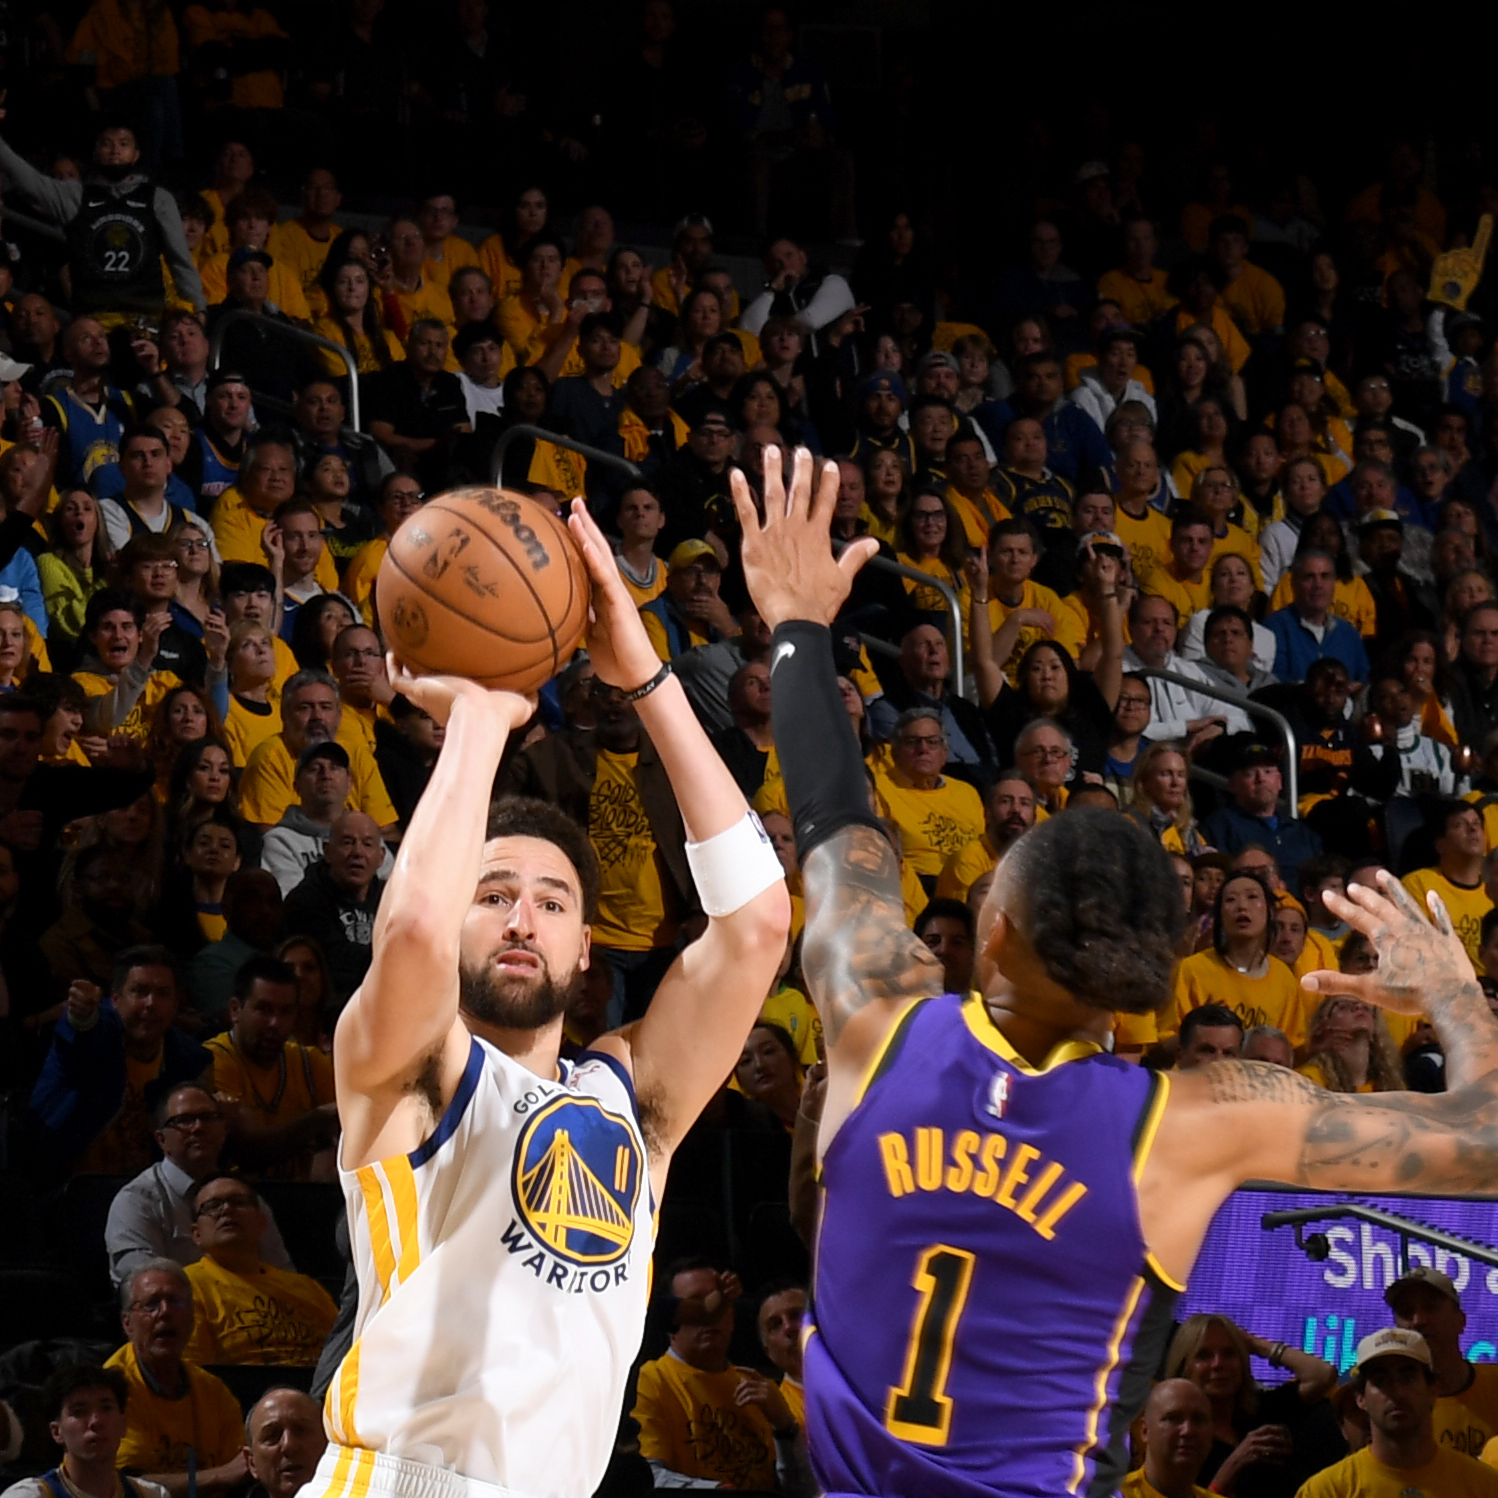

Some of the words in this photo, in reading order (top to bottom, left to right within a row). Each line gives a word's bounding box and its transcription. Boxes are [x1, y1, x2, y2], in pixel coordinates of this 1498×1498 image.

[104, 248, 131, 274] 22
[614, 1144, 631, 1194] 11
[878, 1126, 1089, 1241] RUSSELL
[885, 1244, 977, 1447] 1
